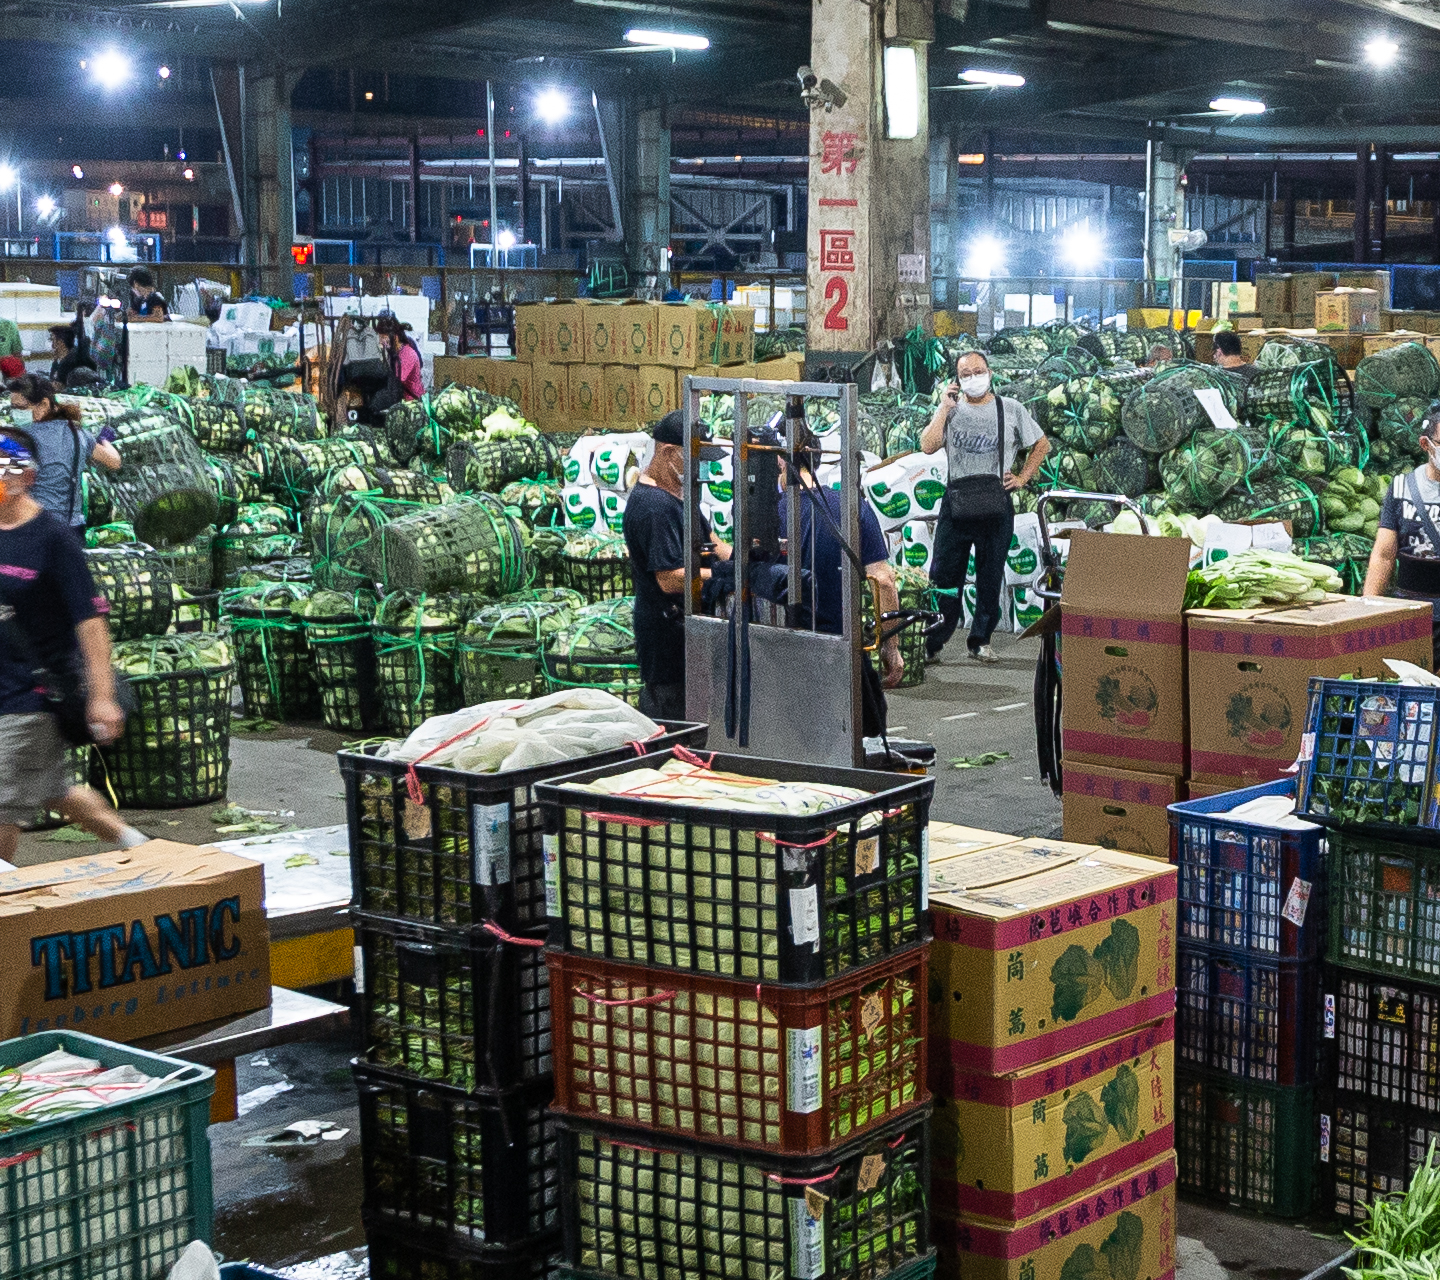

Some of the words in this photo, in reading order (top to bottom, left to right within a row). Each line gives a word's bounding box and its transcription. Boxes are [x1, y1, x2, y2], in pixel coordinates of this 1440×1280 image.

[819, 130, 858, 332] 第一區2
[30, 895, 241, 1003] TITANIC
